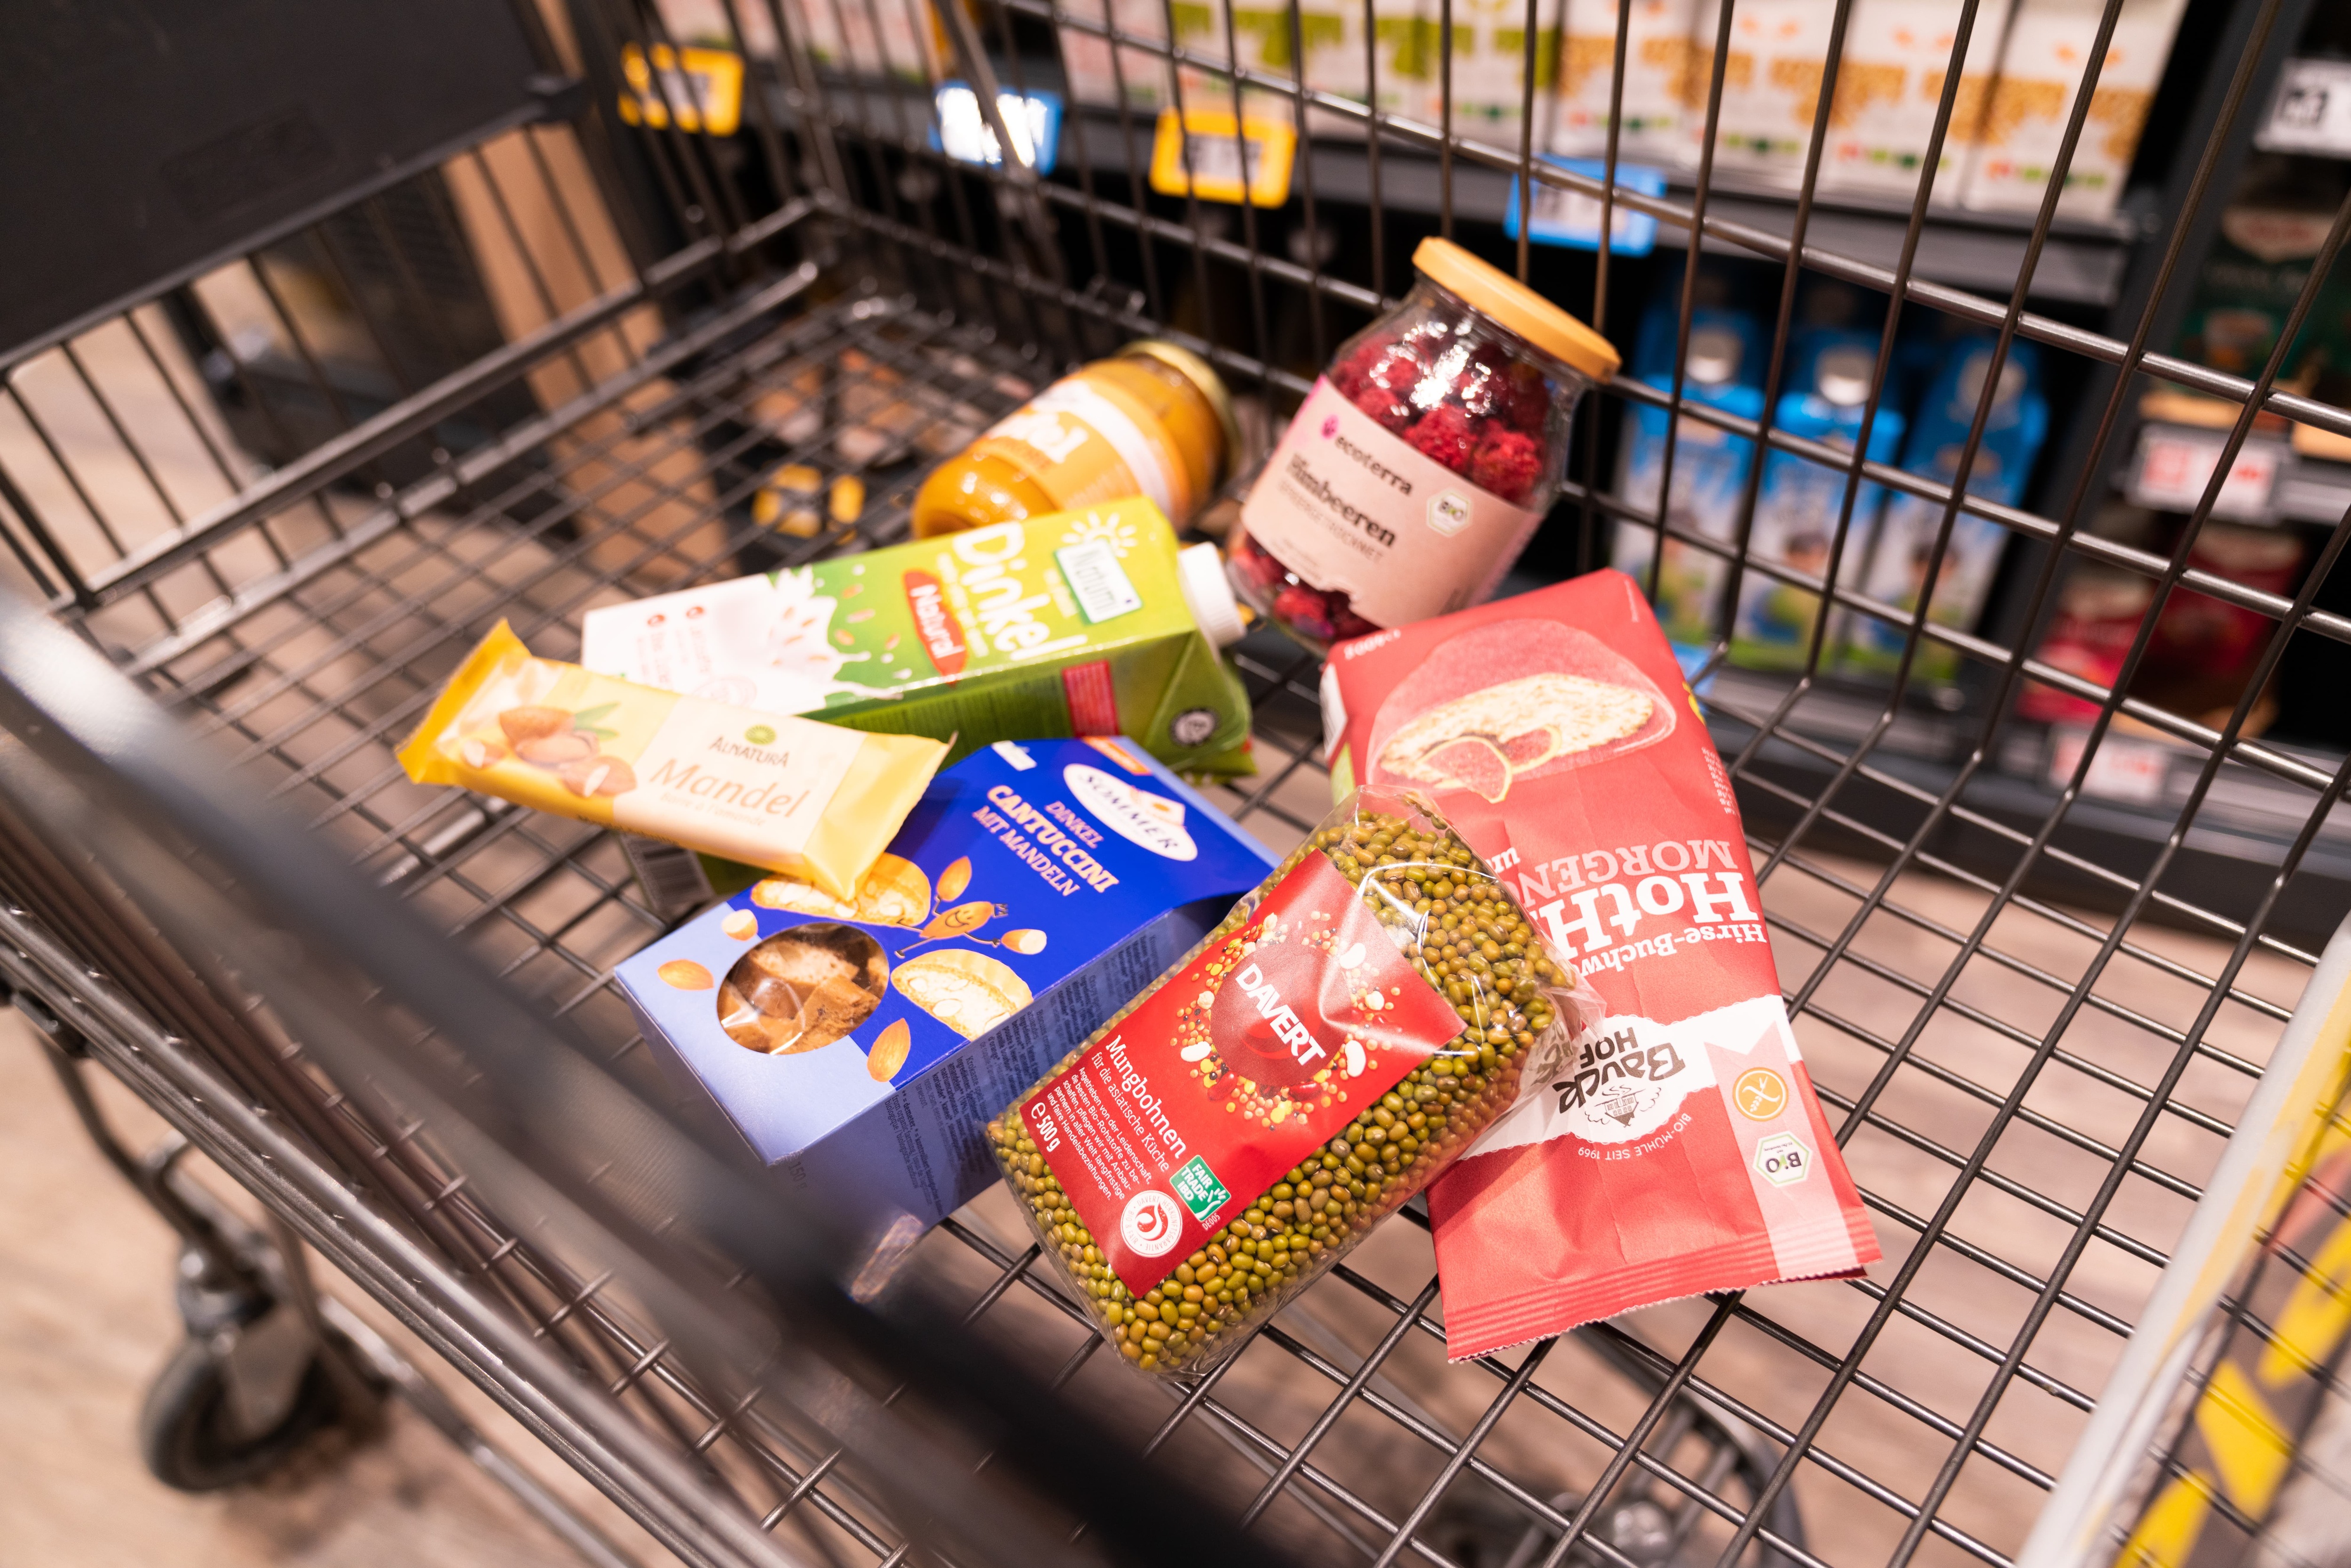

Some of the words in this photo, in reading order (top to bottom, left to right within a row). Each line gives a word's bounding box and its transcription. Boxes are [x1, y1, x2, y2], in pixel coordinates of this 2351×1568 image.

[953, 521, 1088, 661] Dinkel
[910, 583, 966, 658] Natural
[648, 757, 810, 819] Mandel
[972, 805, 1010, 839] MIT
[999, 824, 1081, 897] MANDELN
[987, 785, 1120, 893] CANTUCCINI
[1045, 801, 1103, 849] DINKEL
[1529, 871, 1759, 962] HotH
[1235, 961, 1326, 1066] DAVERT
[1578, 1026, 1638, 1069] HOF
[1091, 1052, 1104, 1069] für
[1099, 1067, 1112, 1084] die
[1108, 1083, 1144, 1136] asiatische
[1141, 1132, 1169, 1173] Küche
[1105, 1034, 1187, 1159] Mungbohnen
[1036, 1115, 1059, 1143] 500
[1046, 1139, 1061, 1152] g
[1047, 1092, 1058, 1106] und
[1053, 1104, 1064, 1121] faire
[1061, 1119, 1112, 1200] Handelsbeziehungen.
[1054, 1086, 1072, 1114] partnern
[1069, 1112, 1075, 1122] in
[1073, 1121, 1086, 1137] aller
[1084, 1135, 1097, 1157] Welt
[1095, 1154, 1125, 1200] langfristige
[1063, 1080, 1079, 1109] schaffen,
[1073, 1107, 1096, 1136] pflegen
[1094, 1135, 1104, 1148] wir
[1102, 1147, 1113, 1162] mit
[1110, 1162, 1131, 1190] Anbau-
[1075, 1082, 1090, 1107] besten
[1088, 1105, 1123, 1159] Bio-Rohstoffe
[1121, 1158, 1131, 1171] zu
[1128, 1168, 1140, 1184] be-
[1079, 1067, 1102, 1106] Angetrieben
[1099, 1104, 1110, 1120] von
[1108, 1119, 1119, 1132] der
[1116, 1131, 1152, 1185] Leidenschaft,
[1578, 1147, 1600, 1159] 1969
[1603, 1147, 1631, 1161] SEIT
[1633, 1112, 1692, 1156] BIO-MÜHLE
[1137, 1195, 1160, 1206] DAVERT
[1177, 1181, 1195, 1201] IBD
[1181, 1166, 1208, 1202] TRADE
[1192, 1163, 1213, 1189] FAIR
[1128, 1232, 1139, 1244] FAIR
[1145, 1199, 1178, 1252] HERKUNFTSGARANTIE
[1201, 1213, 1221, 1231] DE005
